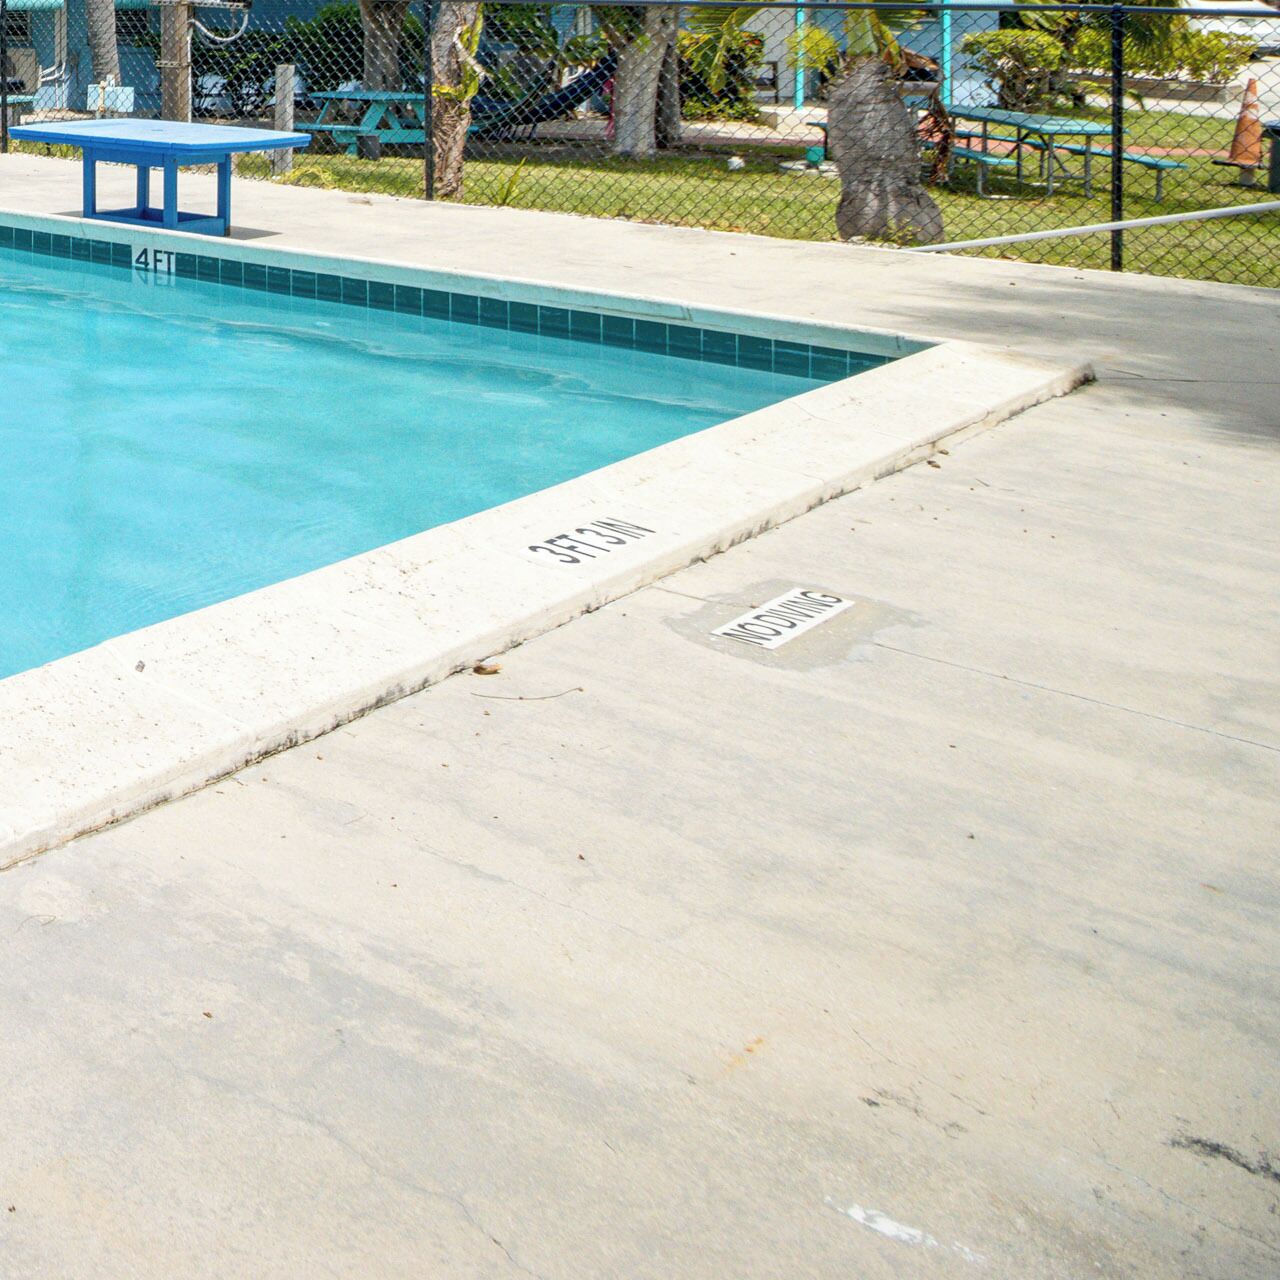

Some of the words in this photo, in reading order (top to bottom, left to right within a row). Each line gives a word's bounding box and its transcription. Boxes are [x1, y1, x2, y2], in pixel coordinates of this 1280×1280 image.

[135, 248, 149, 271] 4
[153, 249, 175, 275] FT
[575, 527, 627, 546] 3
[591, 517, 657, 540] IN
[528, 545, 581, 564] 3
[544, 534, 611, 558] FT
[722, 622, 782, 645] NO
[753, 590, 843, 629] DIVING
